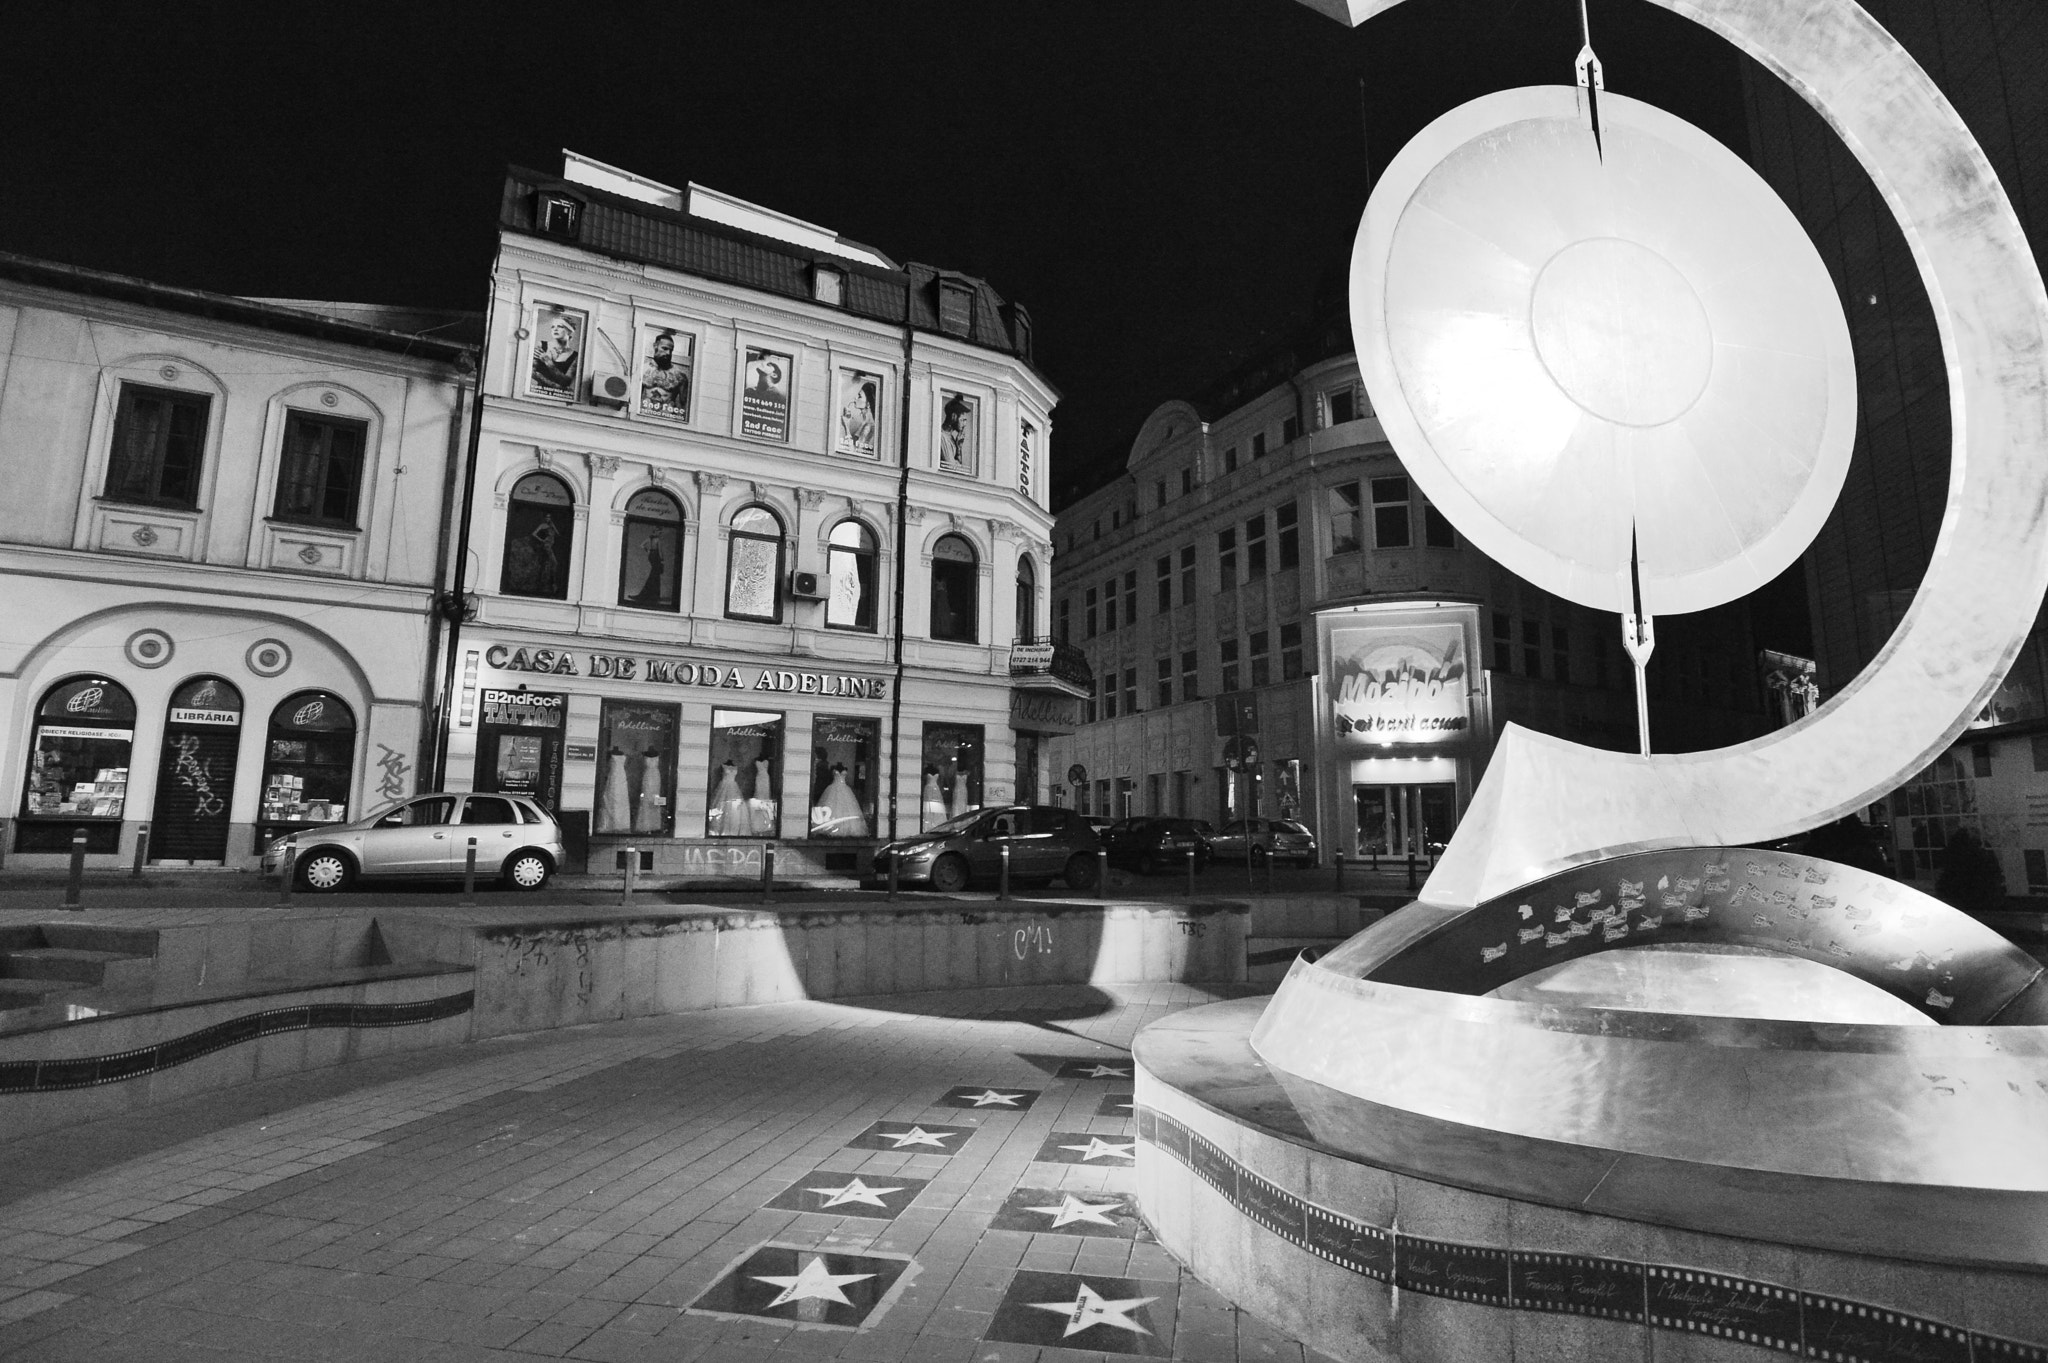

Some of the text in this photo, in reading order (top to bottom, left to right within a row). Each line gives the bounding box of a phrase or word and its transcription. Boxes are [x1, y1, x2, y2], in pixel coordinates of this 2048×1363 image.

[1020, 427, 1030, 497] TATTOO
[486, 645, 887, 699] CASA DE MODA ADELINE
[484, 702, 561, 728] TATTOO
[498, 691, 562, 707] 2ndFace
